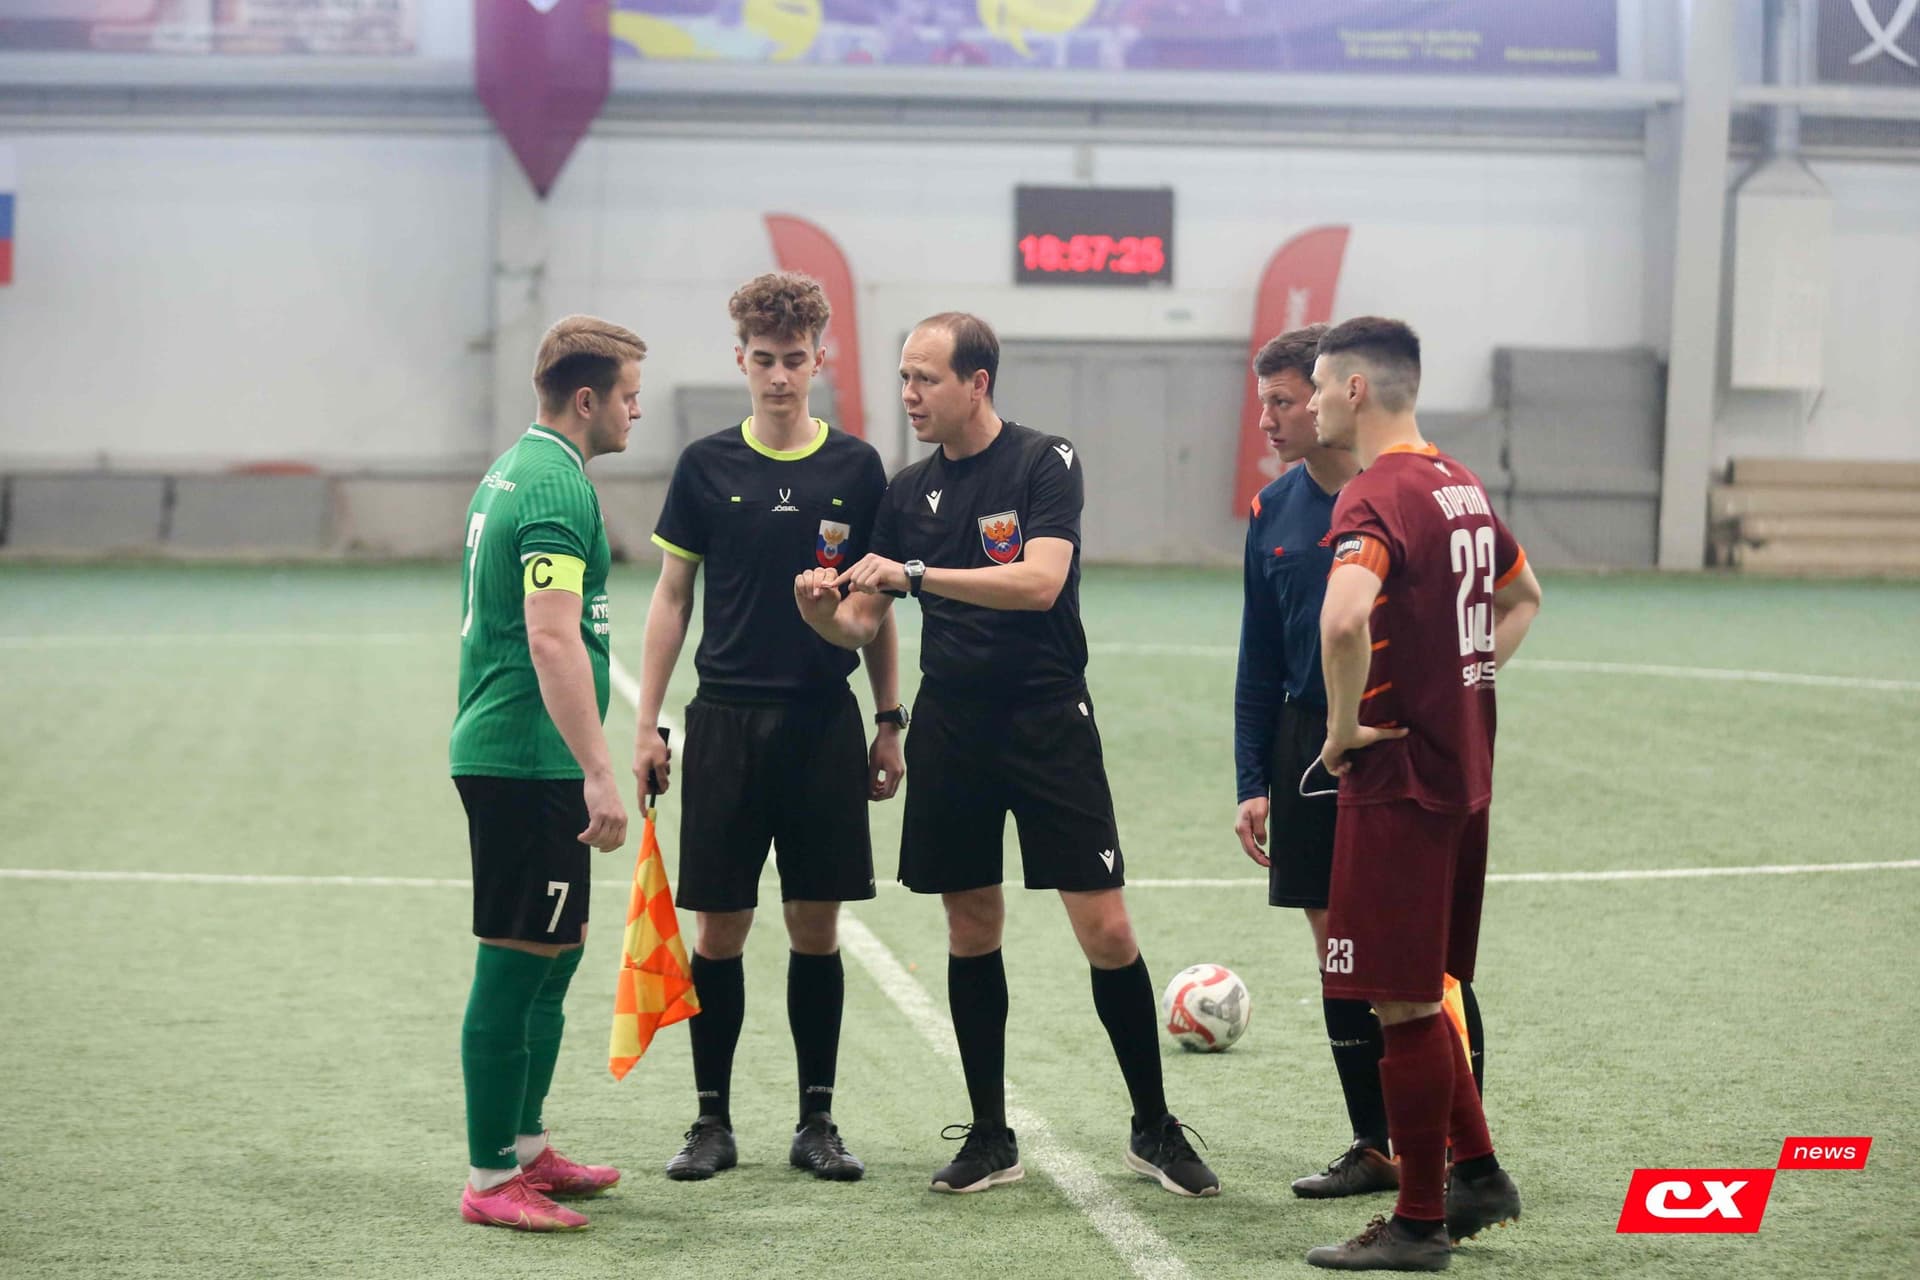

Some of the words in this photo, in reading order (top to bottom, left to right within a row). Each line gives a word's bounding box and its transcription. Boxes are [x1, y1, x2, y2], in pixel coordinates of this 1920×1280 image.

[532, 557, 553, 588] C
[1450, 526, 1496, 657] 23
[547, 881, 569, 933] 7
[1326, 937, 1354, 974] 23
